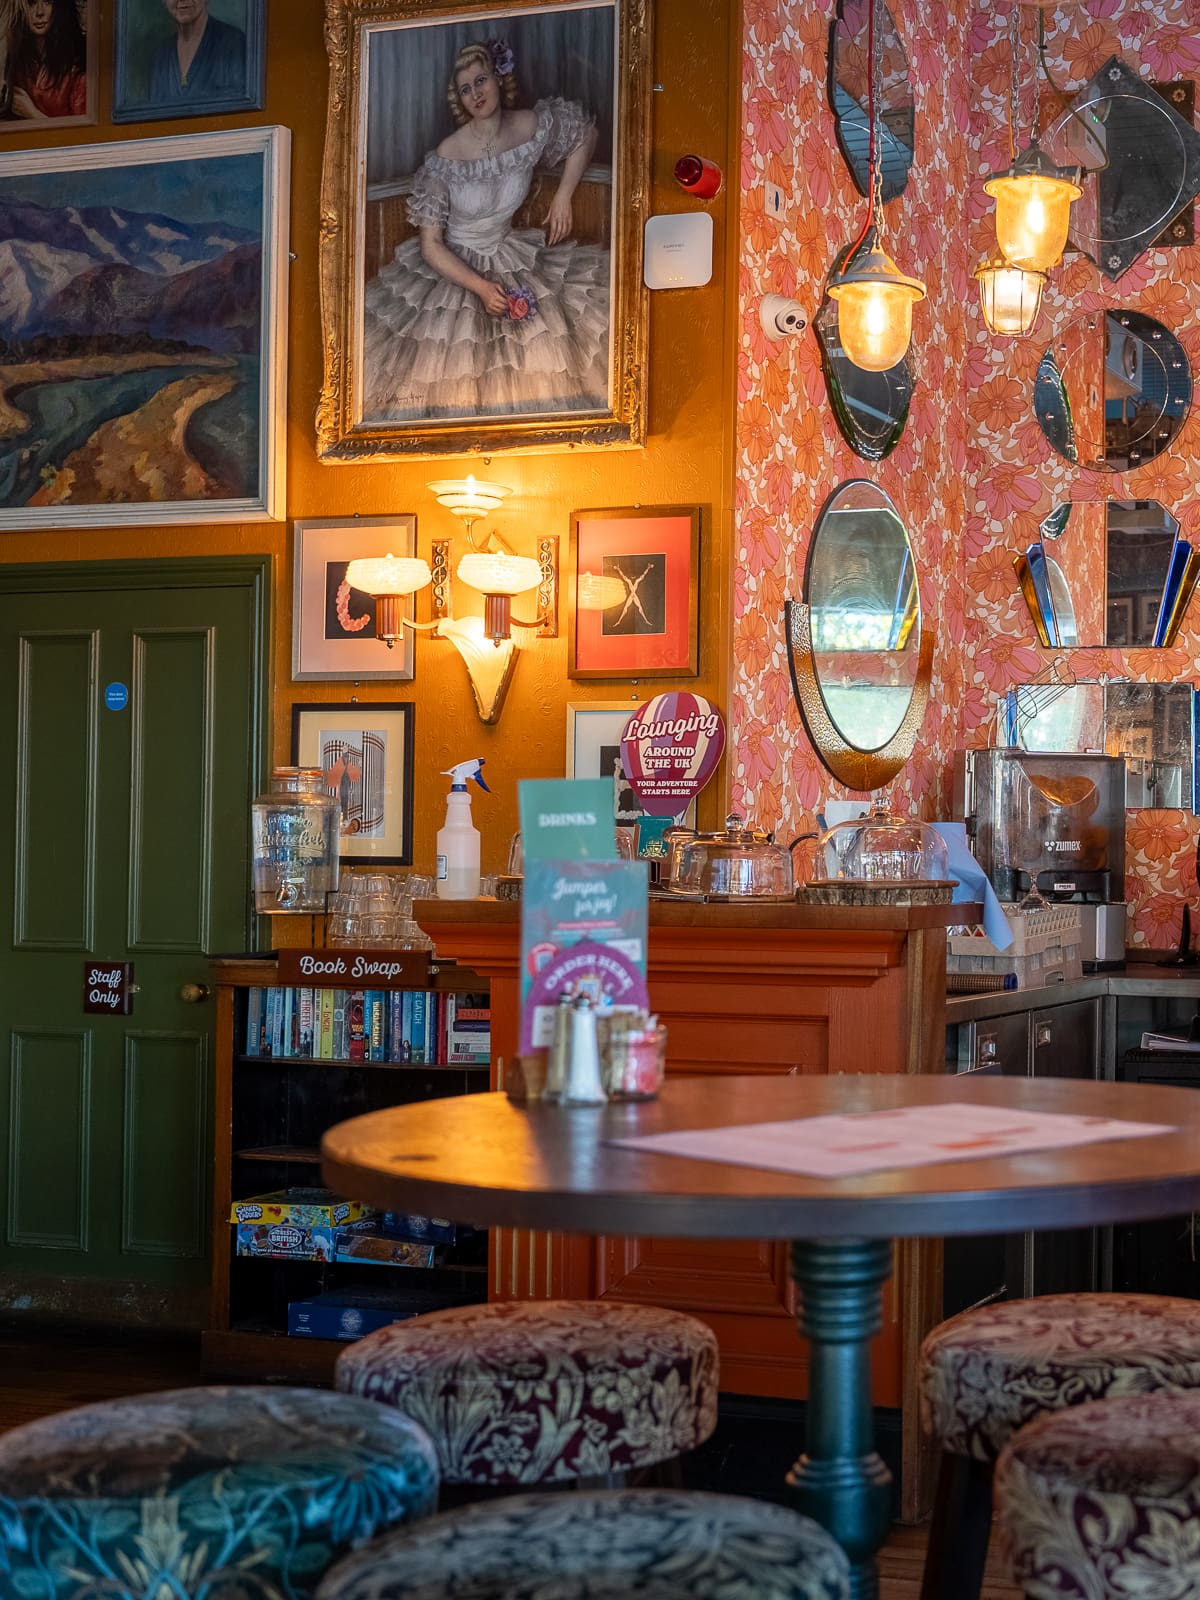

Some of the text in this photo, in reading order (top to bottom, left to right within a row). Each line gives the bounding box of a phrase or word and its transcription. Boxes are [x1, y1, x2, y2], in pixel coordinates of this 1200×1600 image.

[623, 712, 719, 742] Lounging
[645, 747, 695, 757] AROUND
[646, 758, 692, 769] THE UK
[539, 812, 597, 828] DRINKS
[1055, 840, 1081, 851] zumex
[300, 956, 403, 980] Book Swap
[544, 953, 635, 995] ORDER HERE
[88, 968, 122, 988] Staff
[89, 989, 121, 1008] Only
[415, 1000, 423, 1025] CATCH
[271, 1234, 298, 1244] BRITISH
